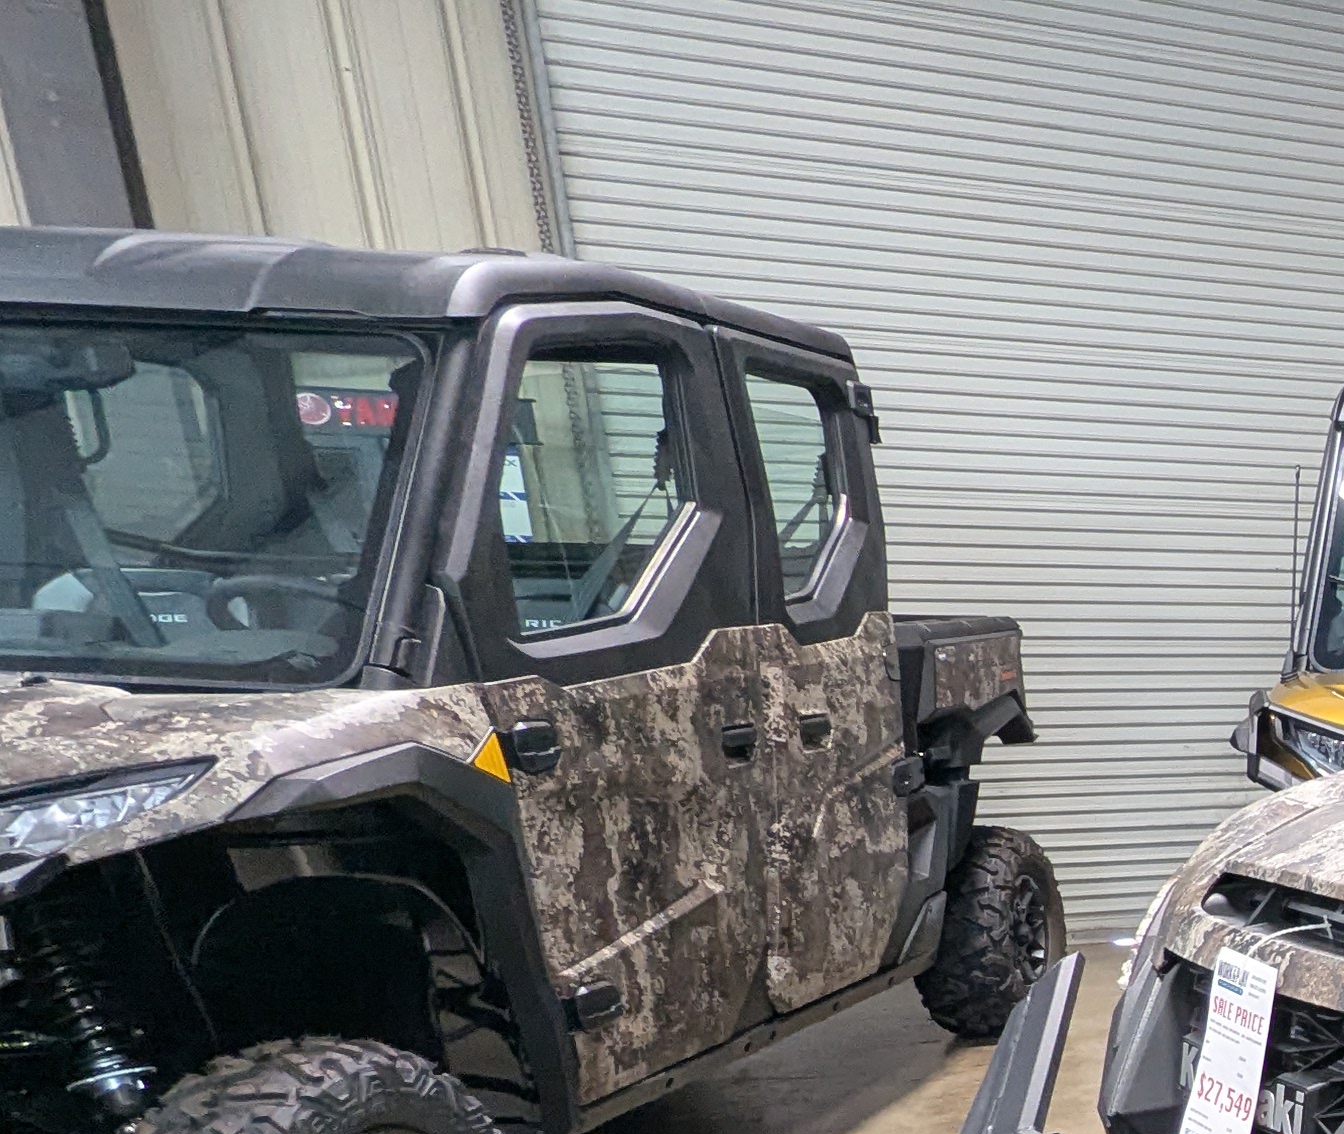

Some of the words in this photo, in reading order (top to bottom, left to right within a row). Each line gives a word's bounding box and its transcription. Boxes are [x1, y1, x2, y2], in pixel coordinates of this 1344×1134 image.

[1213, 995, 1234, 1021] SALE
[1234, 1006, 1265, 1036] PRICE
[1197, 1071, 1253, 1122] $27,549
